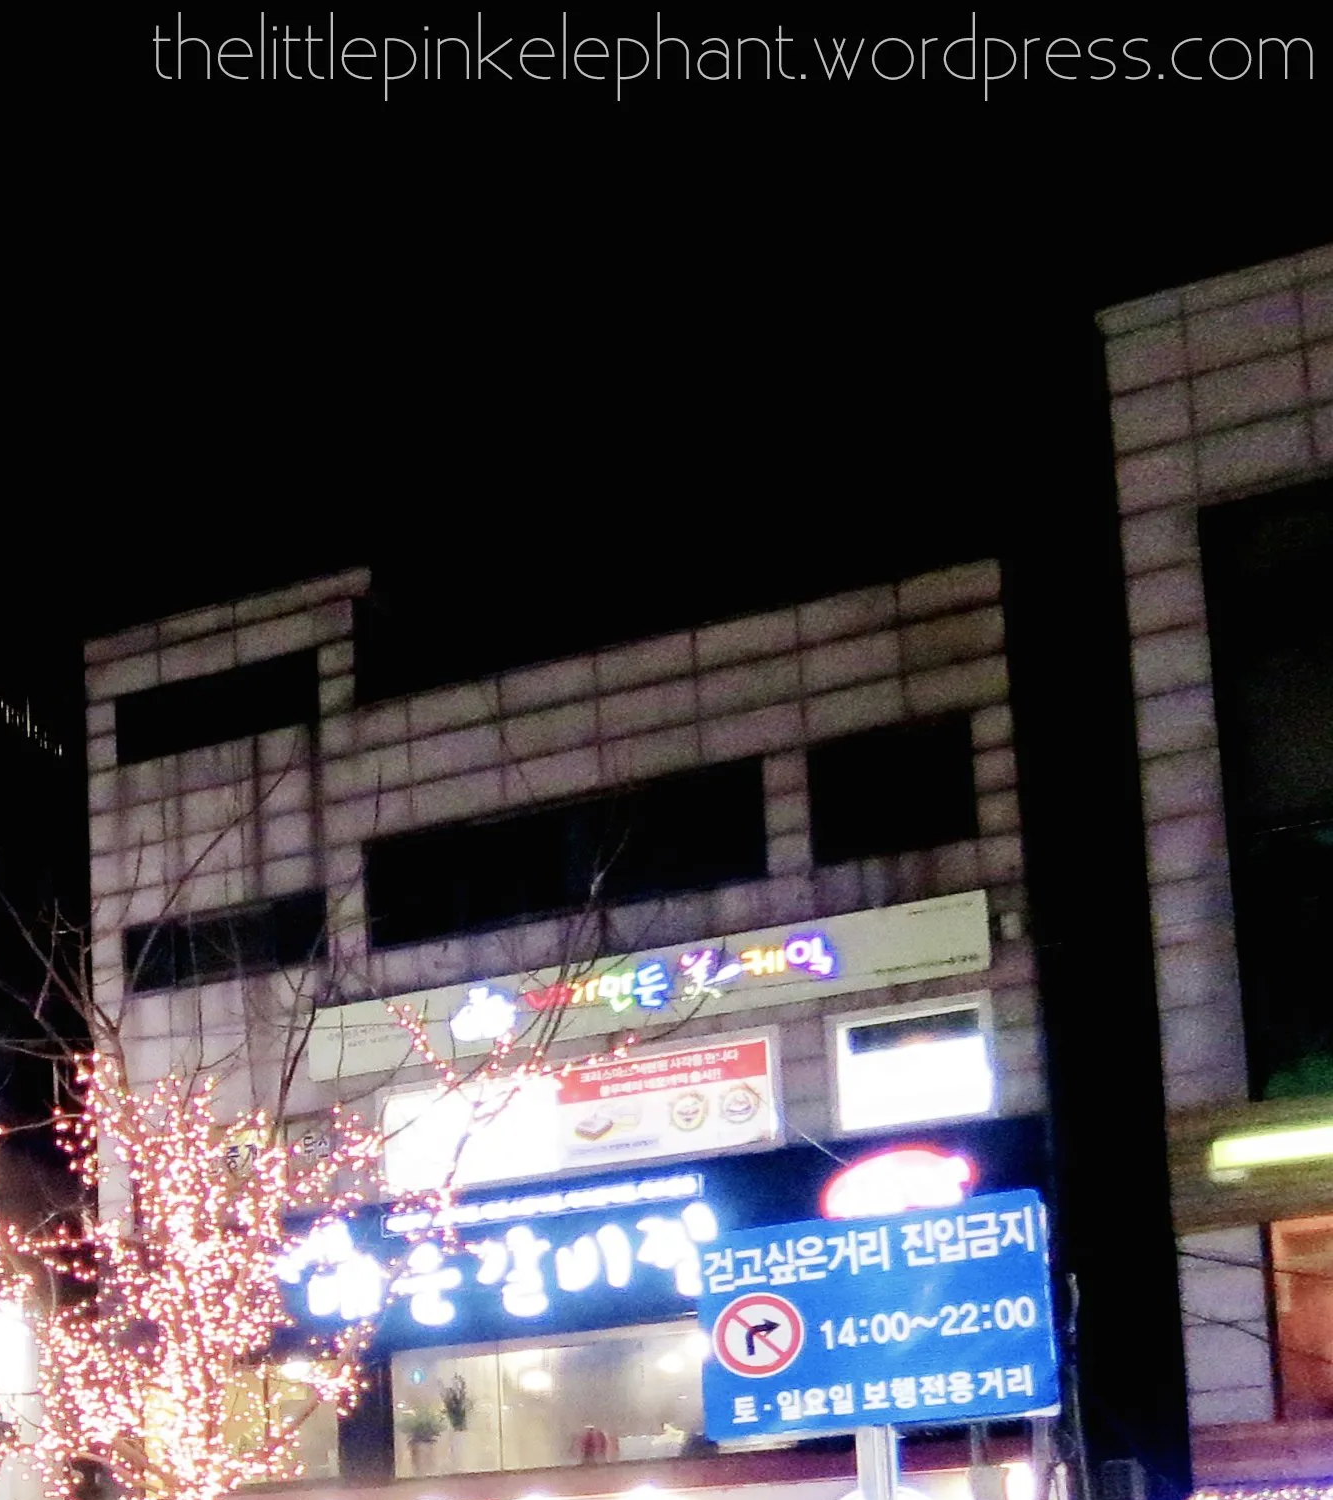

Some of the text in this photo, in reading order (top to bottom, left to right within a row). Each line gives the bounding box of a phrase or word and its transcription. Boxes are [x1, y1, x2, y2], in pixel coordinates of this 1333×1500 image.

[703, 1206, 1035, 1294] 걷고싶은거리 진입금지
[820, 1296, 1036, 1350] 14:00~22:00
